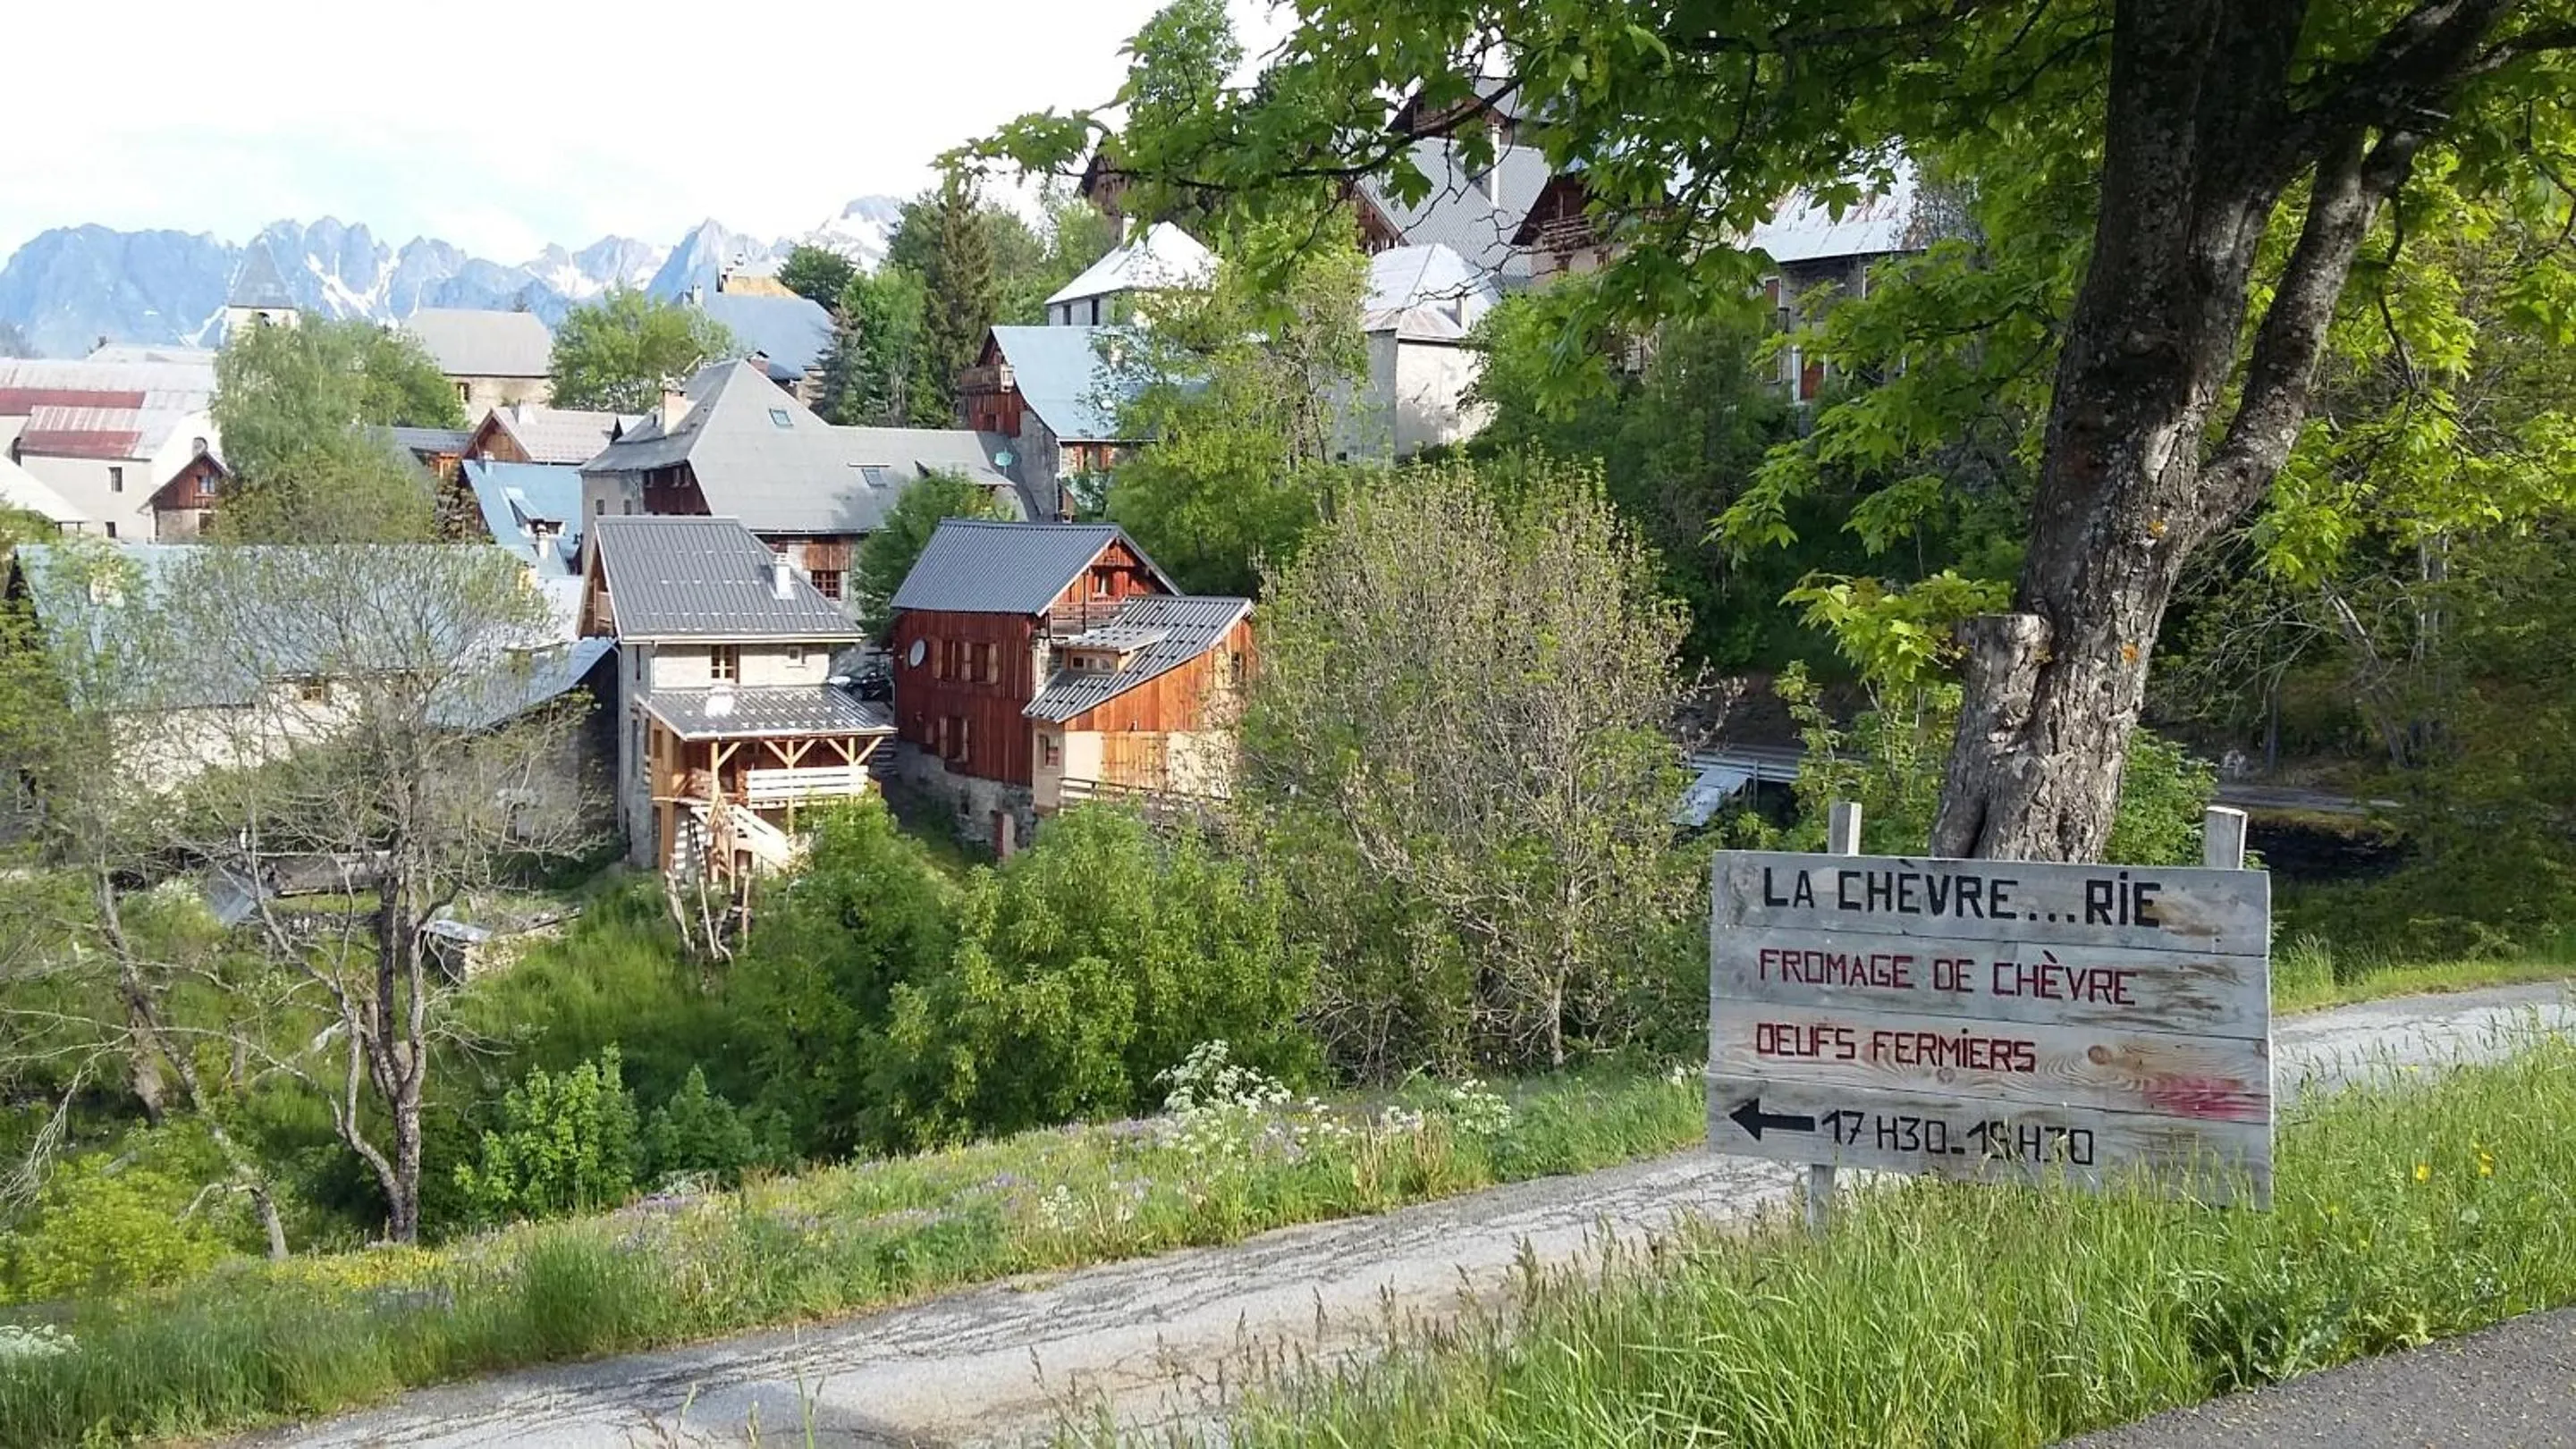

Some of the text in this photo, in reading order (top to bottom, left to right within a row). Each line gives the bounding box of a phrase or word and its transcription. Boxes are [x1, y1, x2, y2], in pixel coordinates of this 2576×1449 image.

[1763, 866, 1815, 909] LA
[1760, 948, 2137, 1006] FROMAGE DE CHÈVRE
[1756, 1023, 1856, 1059] OEUFS
[1821, 1109, 1865, 1145] 17
